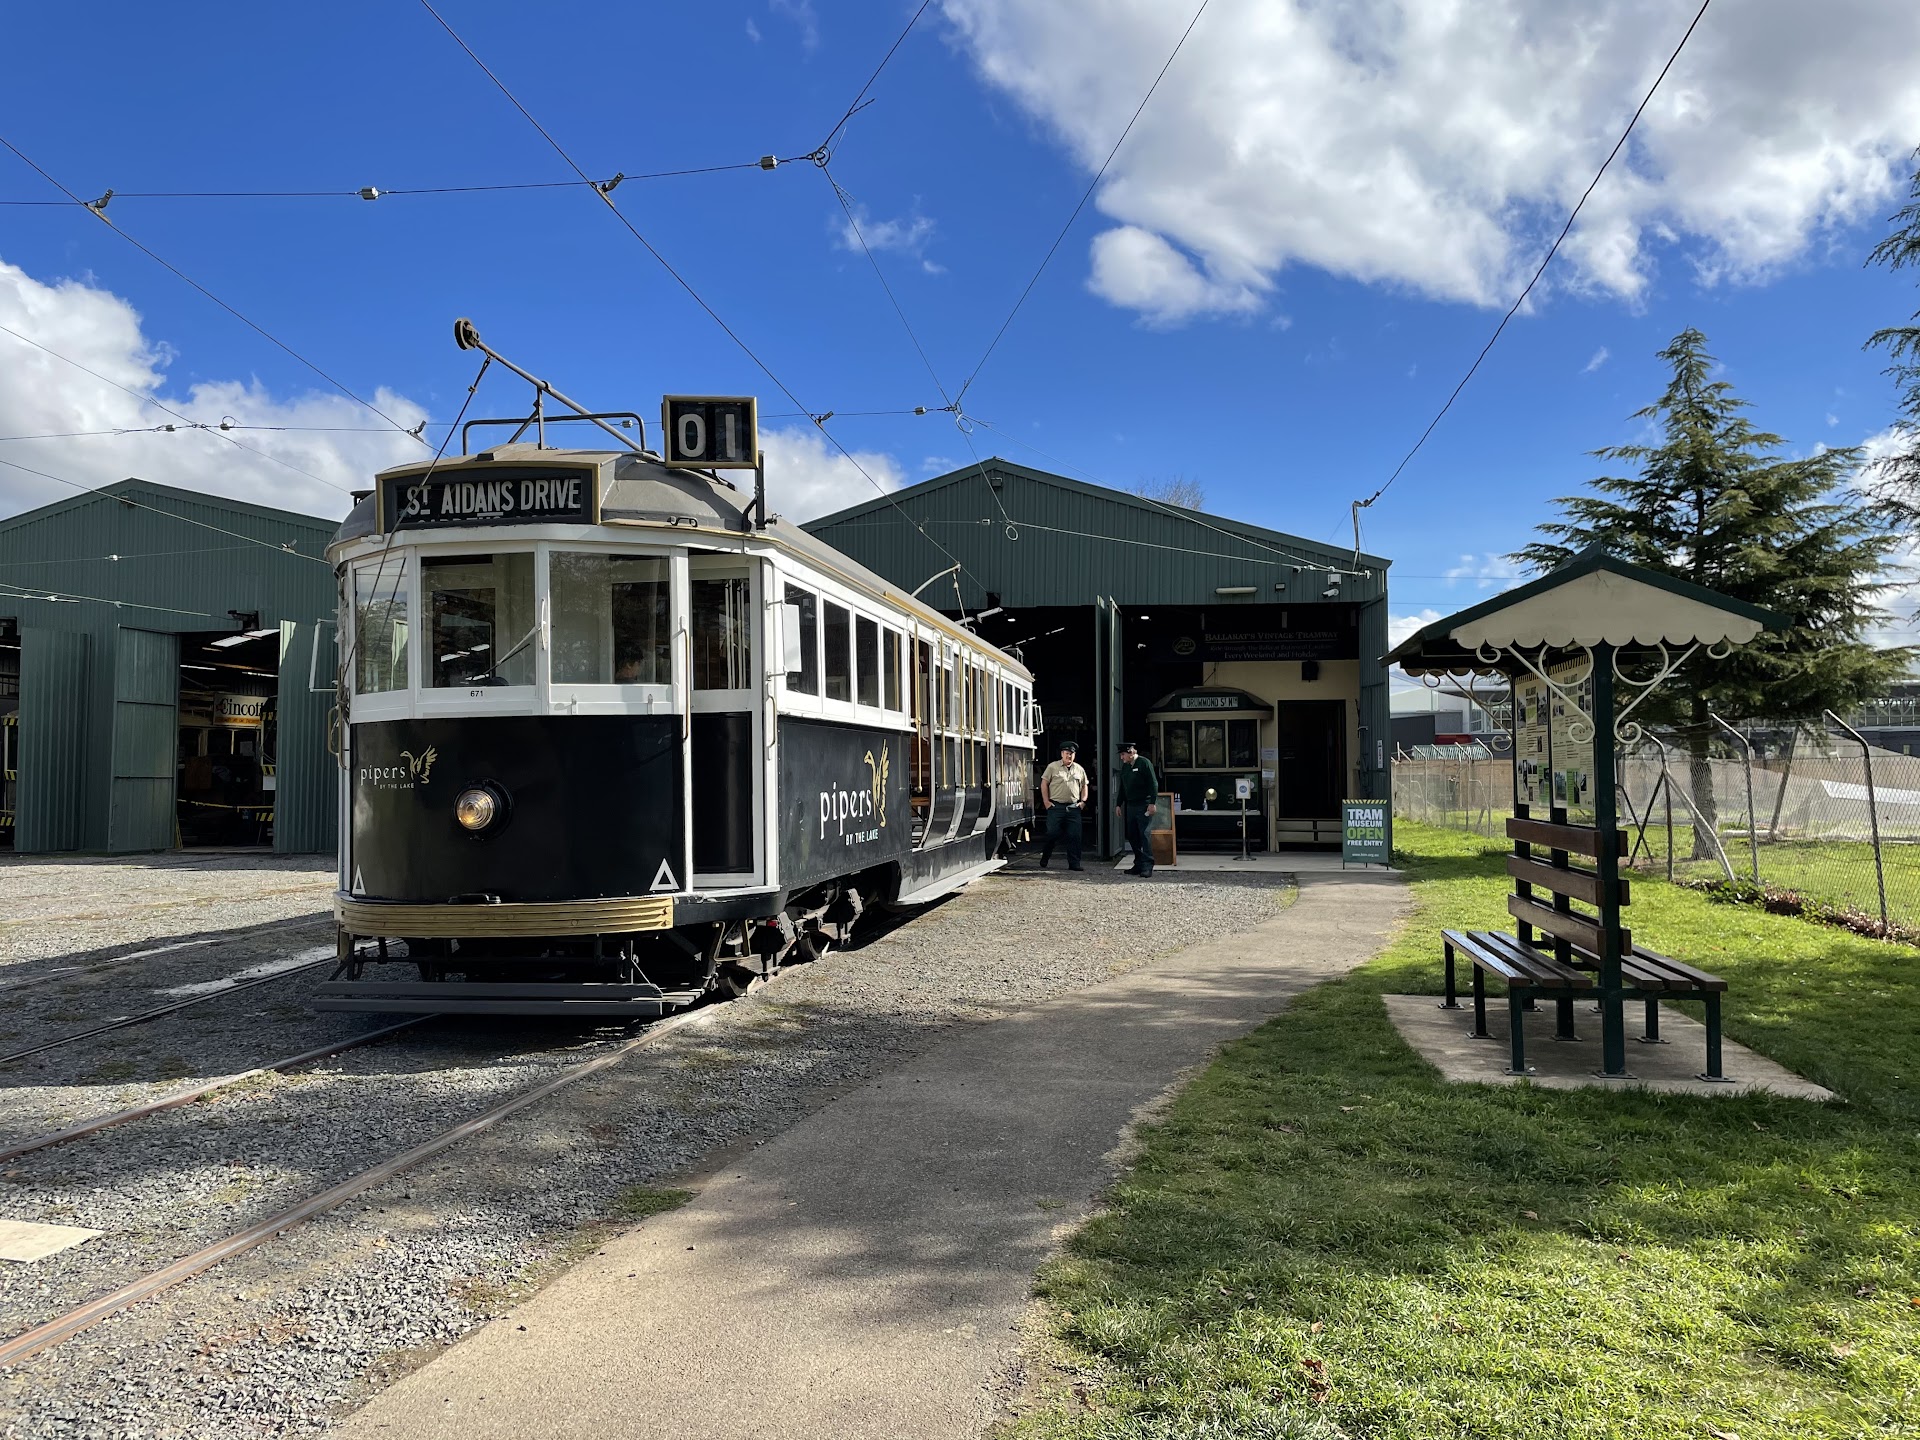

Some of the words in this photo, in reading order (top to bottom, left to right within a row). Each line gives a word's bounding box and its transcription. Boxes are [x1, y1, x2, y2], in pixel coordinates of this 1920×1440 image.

[441, 480, 515, 515] AIDANS
[520, 479, 582, 512] DRIVE
[1242, 651, 1276, 659] Weekend
[1186, 698, 1219, 708] DRUMMOND
[360, 764, 406, 786] pipers
[819, 781, 872, 840] pipers
[1347, 808, 1383, 820] TRAM
[1347, 820, 1383, 828] MUSEUM
[846, 834, 854, 846] BY
[855, 831, 865, 843] THE
[866, 829, 879, 842] LAKE
[1346, 827, 1384, 840] OPEN
